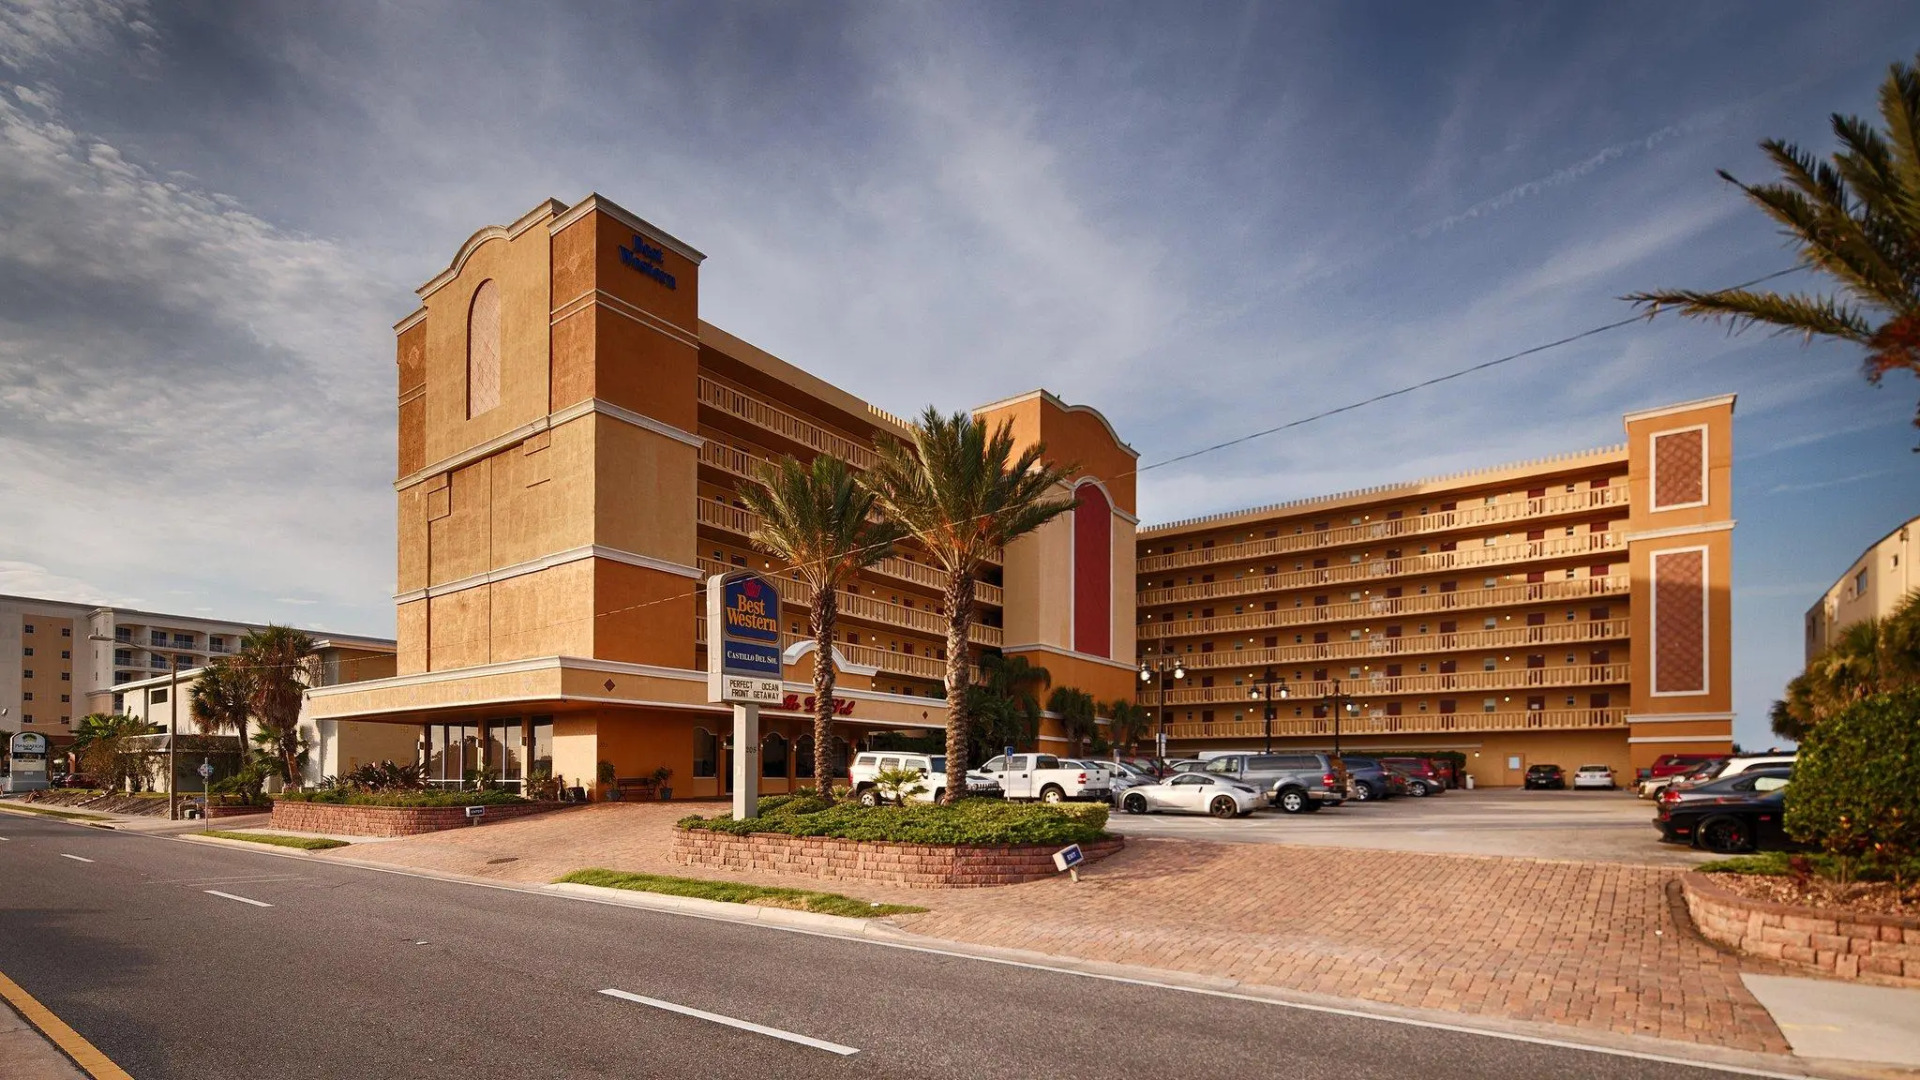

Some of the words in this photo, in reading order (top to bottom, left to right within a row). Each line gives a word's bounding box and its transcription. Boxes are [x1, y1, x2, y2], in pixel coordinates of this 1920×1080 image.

[633, 235, 663, 263] Best
[619, 246, 676, 290] Western
[737, 594, 765, 616] Best
[726, 607, 777, 632] Western
[729, 679, 753, 690] PERFECT
[761, 682, 779, 692] OCEAN
[731, 688, 750, 698] FRONT
[753, 690, 780, 700] GETAWAY
